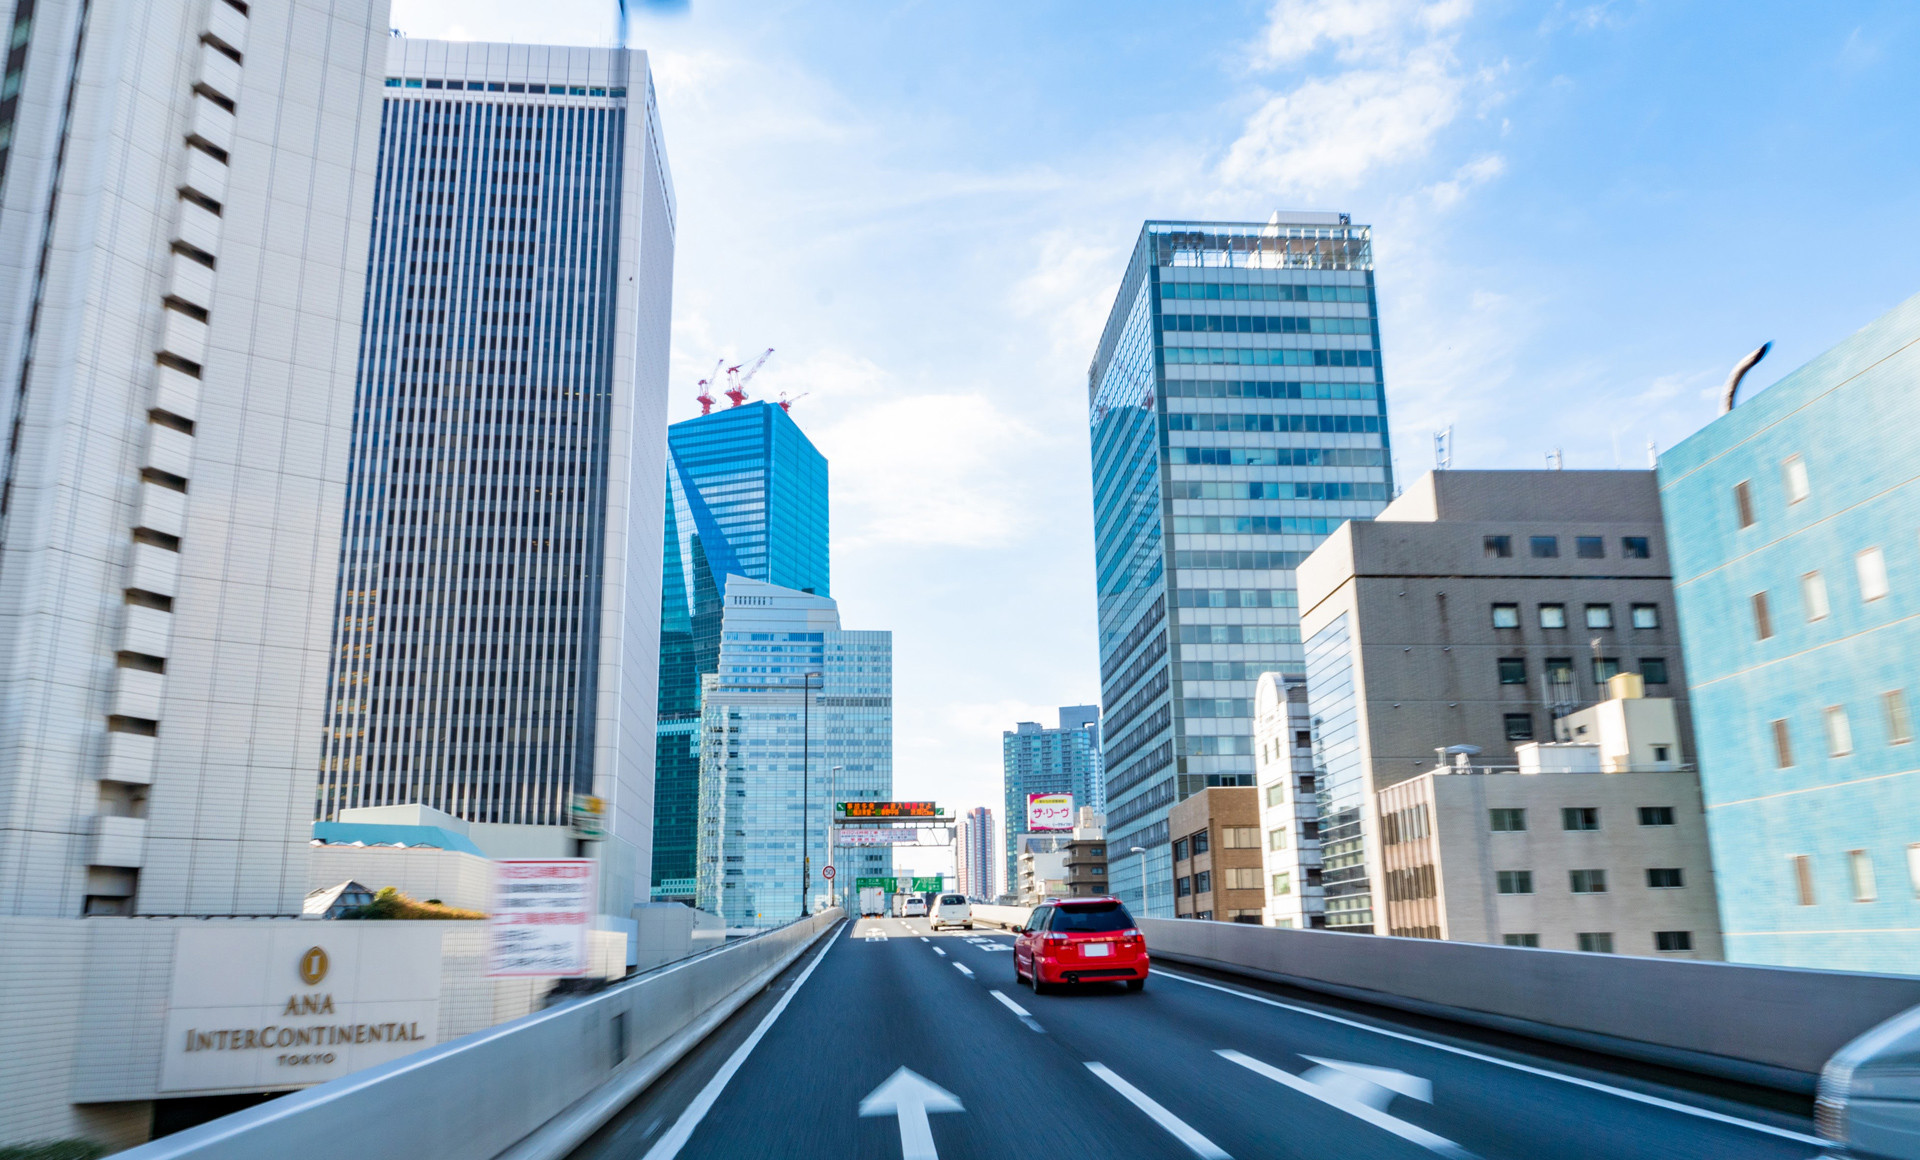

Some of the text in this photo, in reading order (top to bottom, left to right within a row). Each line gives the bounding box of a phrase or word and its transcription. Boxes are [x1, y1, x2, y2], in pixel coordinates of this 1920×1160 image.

[1032, 807, 1070, 819] ザ・リーヴ
[825, 868, 834, 876] 50
[282, 993, 336, 1017] ANA
[276, 1052, 337, 1066] TOKYO
